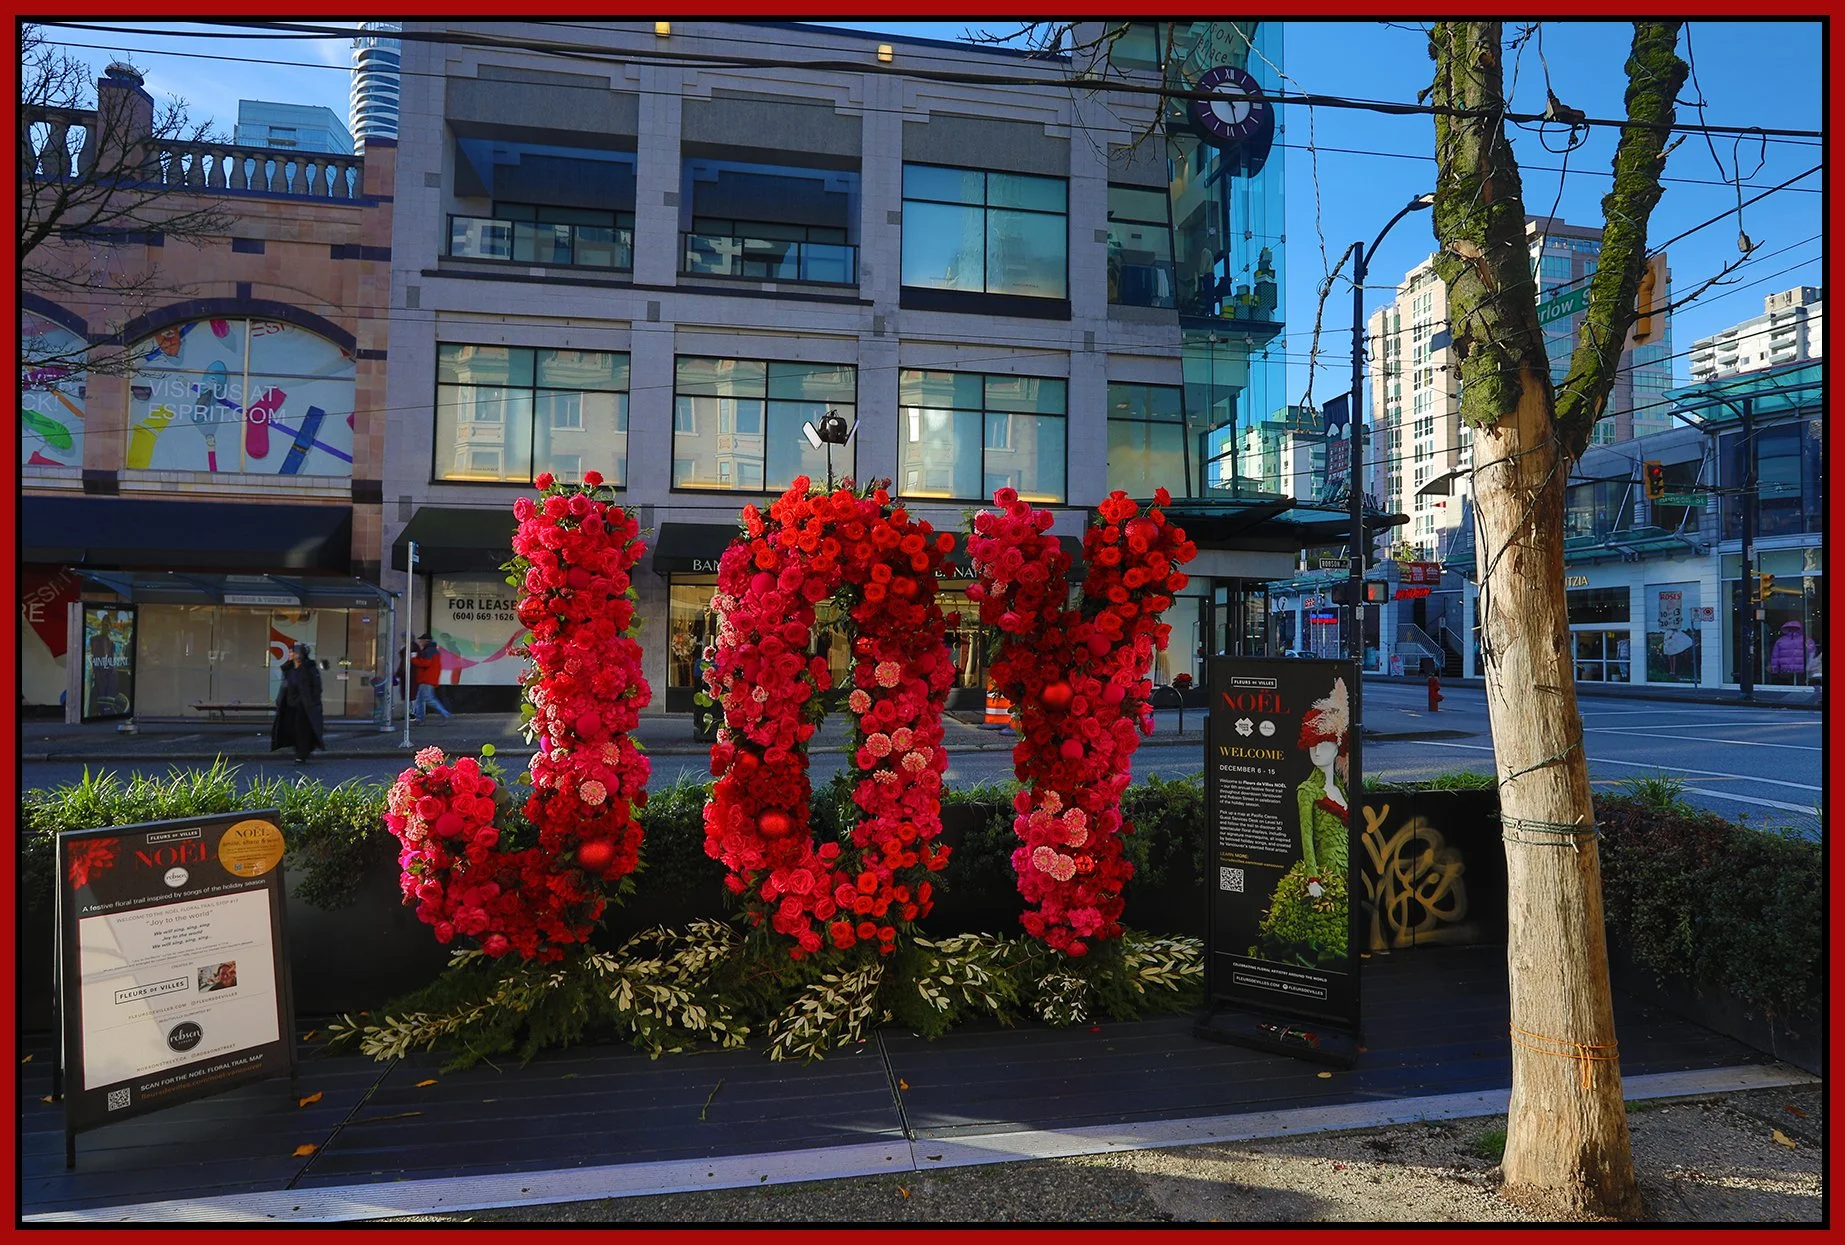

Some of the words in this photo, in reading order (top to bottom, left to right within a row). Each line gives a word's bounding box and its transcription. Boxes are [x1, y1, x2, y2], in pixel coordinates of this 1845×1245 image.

[150, 380, 200, 400] VISIT
[212, 383, 241, 401] US
[250, 384, 277, 402] AT
[149, 403, 286, 425] ESPRIT.COM
[449, 599, 474, 610] FOR
[478, 599, 517, 611] LEASE
[453, 612, 474, 621] (604)
[476, 613, 514, 621] 669-1626
[1221, 689, 1291, 714] NOËL
[1219, 746, 1284, 761] WELCOME
[1219, 765, 1255, 773] DECEMBER
[135, 839, 218, 870] NOËL
[90, 902, 113, 911] festive
[114, 899, 132, 907] floral
[133, 896, 146, 904] trail
[147, 892, 172, 903] inspired
[173, 891, 182, 899] by
[183, 889, 201, 897] songs
[211, 884, 221, 892] the
[222, 881, 243, 891] holiday
[120, 988, 147, 999] FLEURS
[160, 981, 184, 991] VILLES
[170, 1029, 202, 1043] robson
[140, 1081, 160, 1091] SCAN
[161, 1077, 175, 1085] FOR
[189, 1068, 207, 1078] NOËL
[207, 1063, 231, 1073] FLORAL
[231, 1058, 248, 1067] TRAIL
[249, 1054, 264, 1062] MAP
